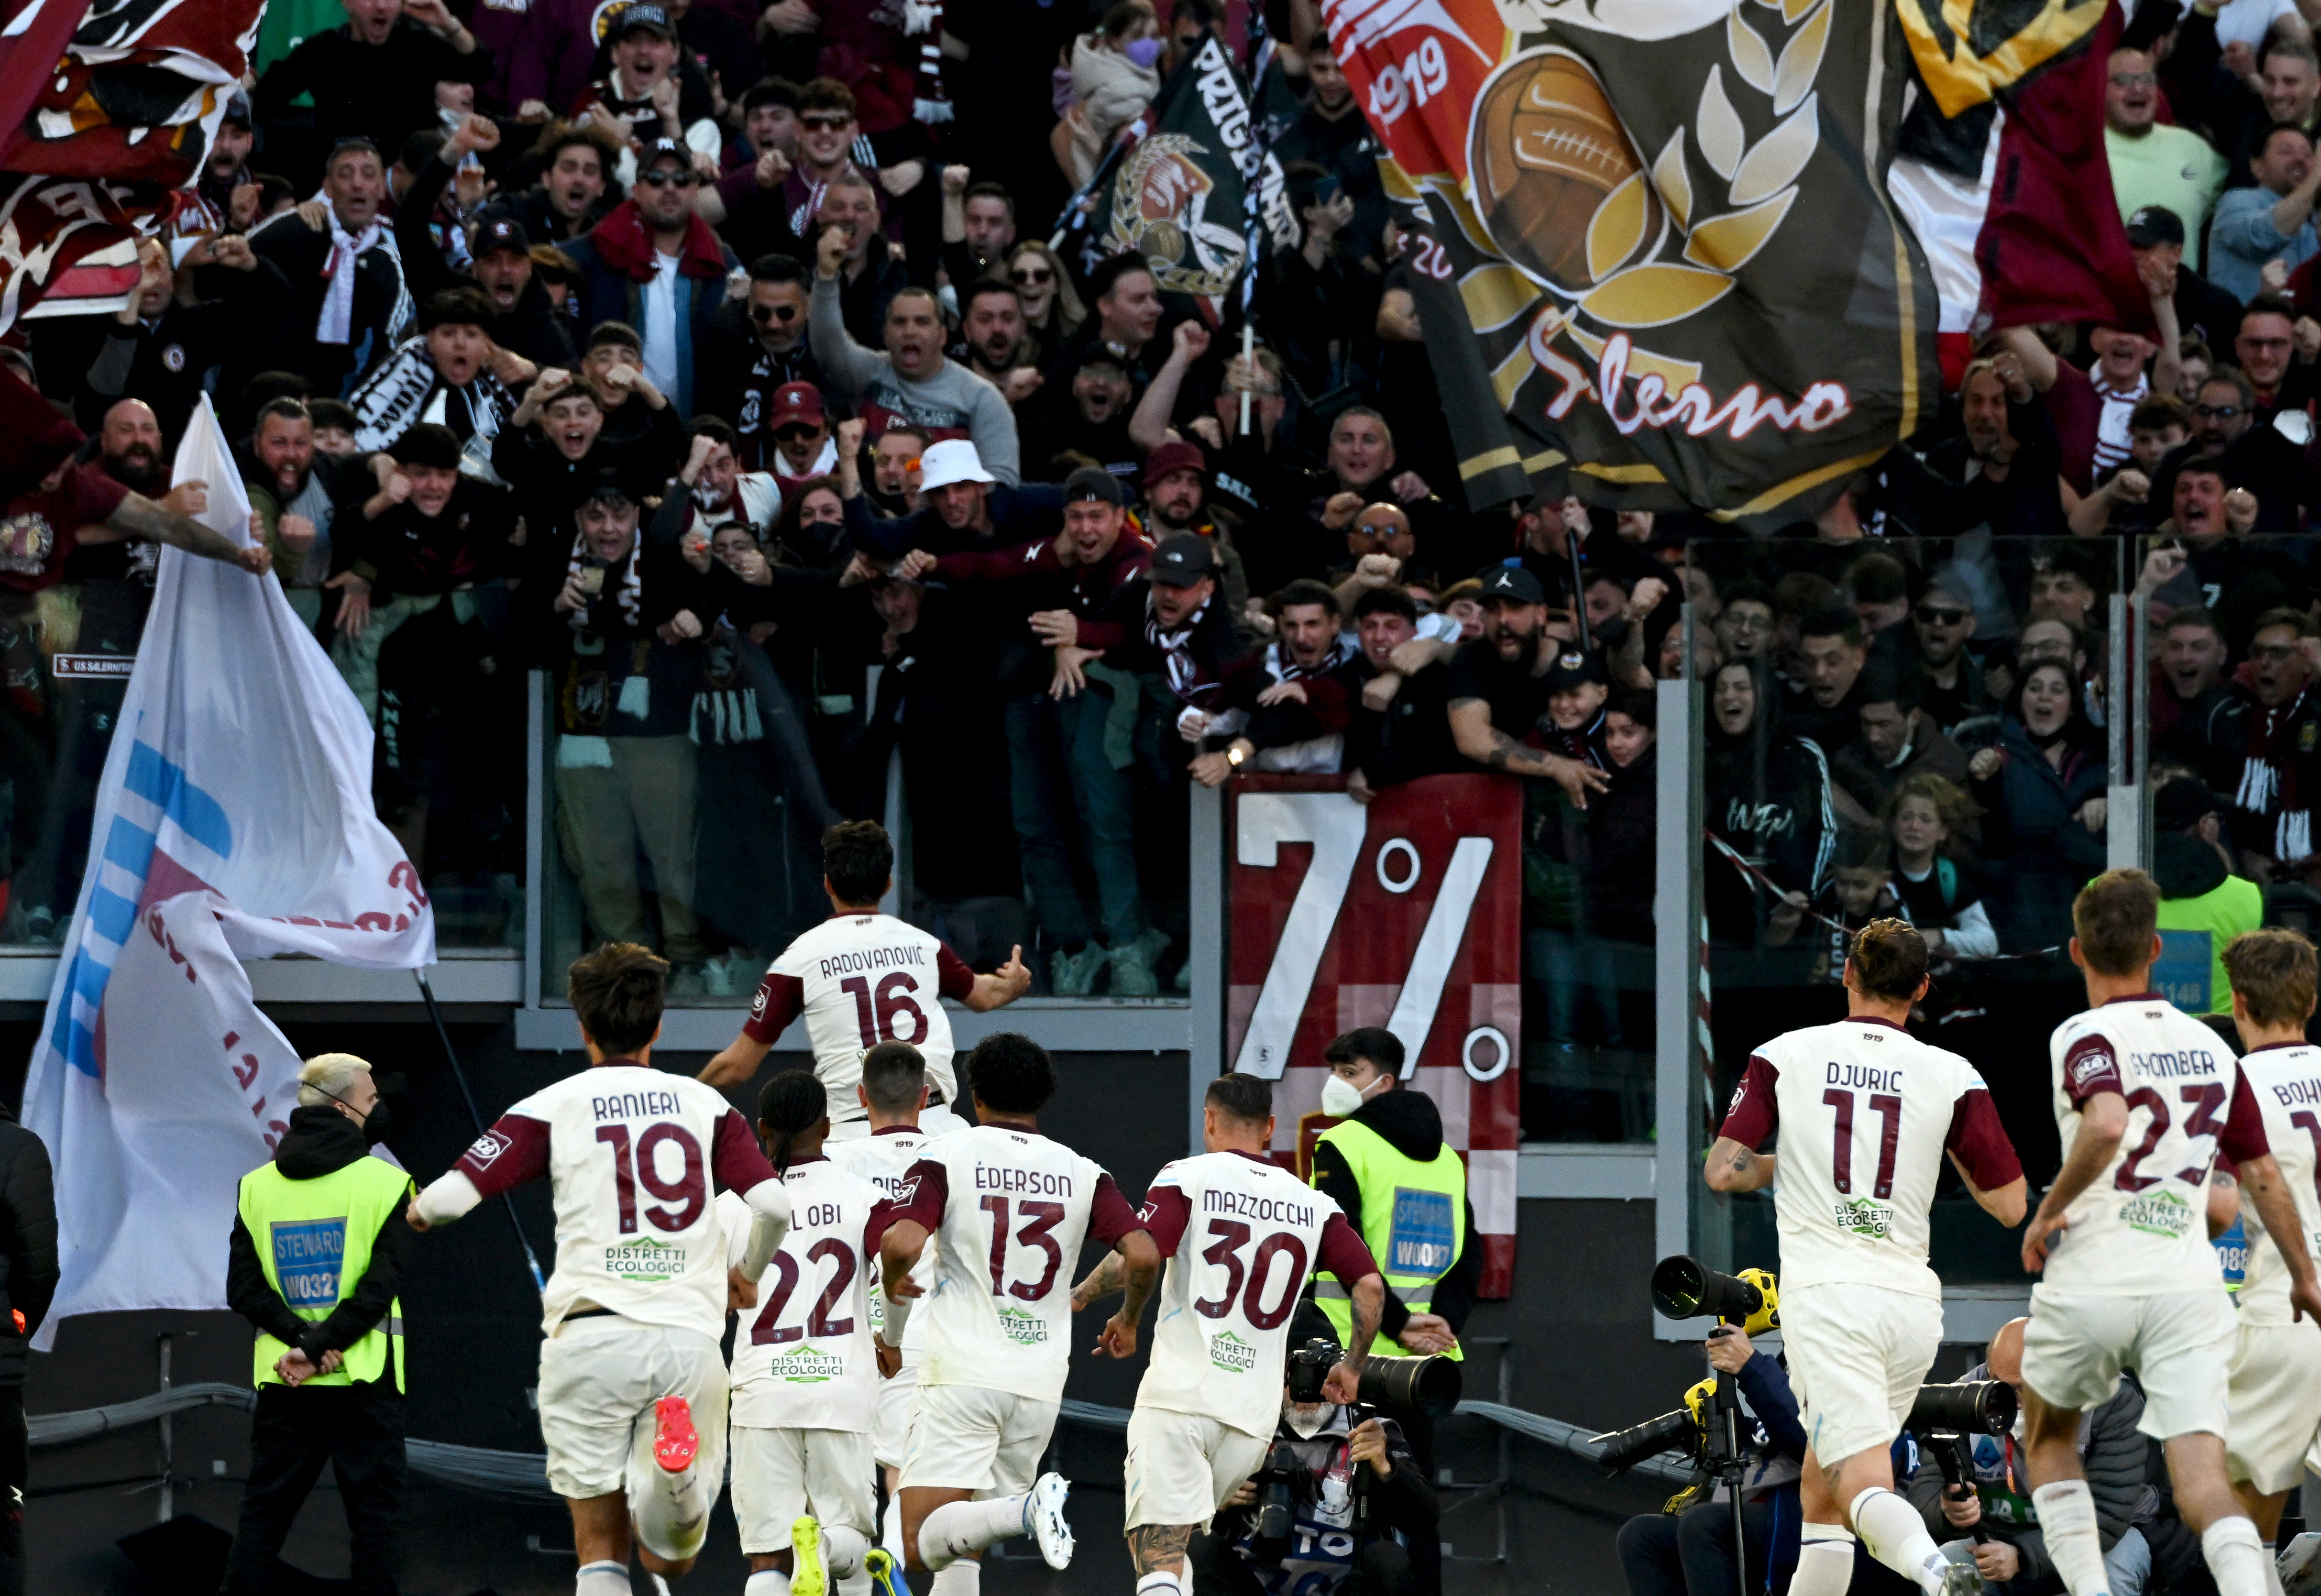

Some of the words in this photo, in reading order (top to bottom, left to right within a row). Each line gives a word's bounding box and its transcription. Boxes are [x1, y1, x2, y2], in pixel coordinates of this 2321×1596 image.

[1529, 305, 1853, 442] Slerno
[841, 972, 928, 1050] 16
[1863, 1033, 1883, 1042] 1919
[1827, 1061, 1902, 1093] DJURIC
[2130, 1050, 2217, 1076] GYOMBER
[592, 1092, 681, 1121] RANIERI
[1010, 1135, 1028, 1146] 1919
[1822, 1087, 1901, 1199] 11
[2114, 1082, 2227, 1192] 23
[595, 1121, 707, 1235] 19
[786, 1171, 806, 1180] 1919
[975, 1161, 1072, 1198] ÉDERSON
[1249, 1168, 1267, 1177] 1919
[808, 1204, 841, 1227] OBI
[1204, 1190, 1314, 1228] MAZZOCCHI
[278, 1230, 344, 1259] STEWARD
[606, 1248, 686, 1260] DISTRETTI
[980, 1195, 1065, 1301] 13
[606, 1261, 685, 1273] ECOLOGICI
[1194, 1218, 1307, 1330] 30
[751, 1237, 857, 1346] 22
[772, 1356, 842, 1367] DISTRETTI
[772, 1365, 843, 1376] ECOLOGICI
